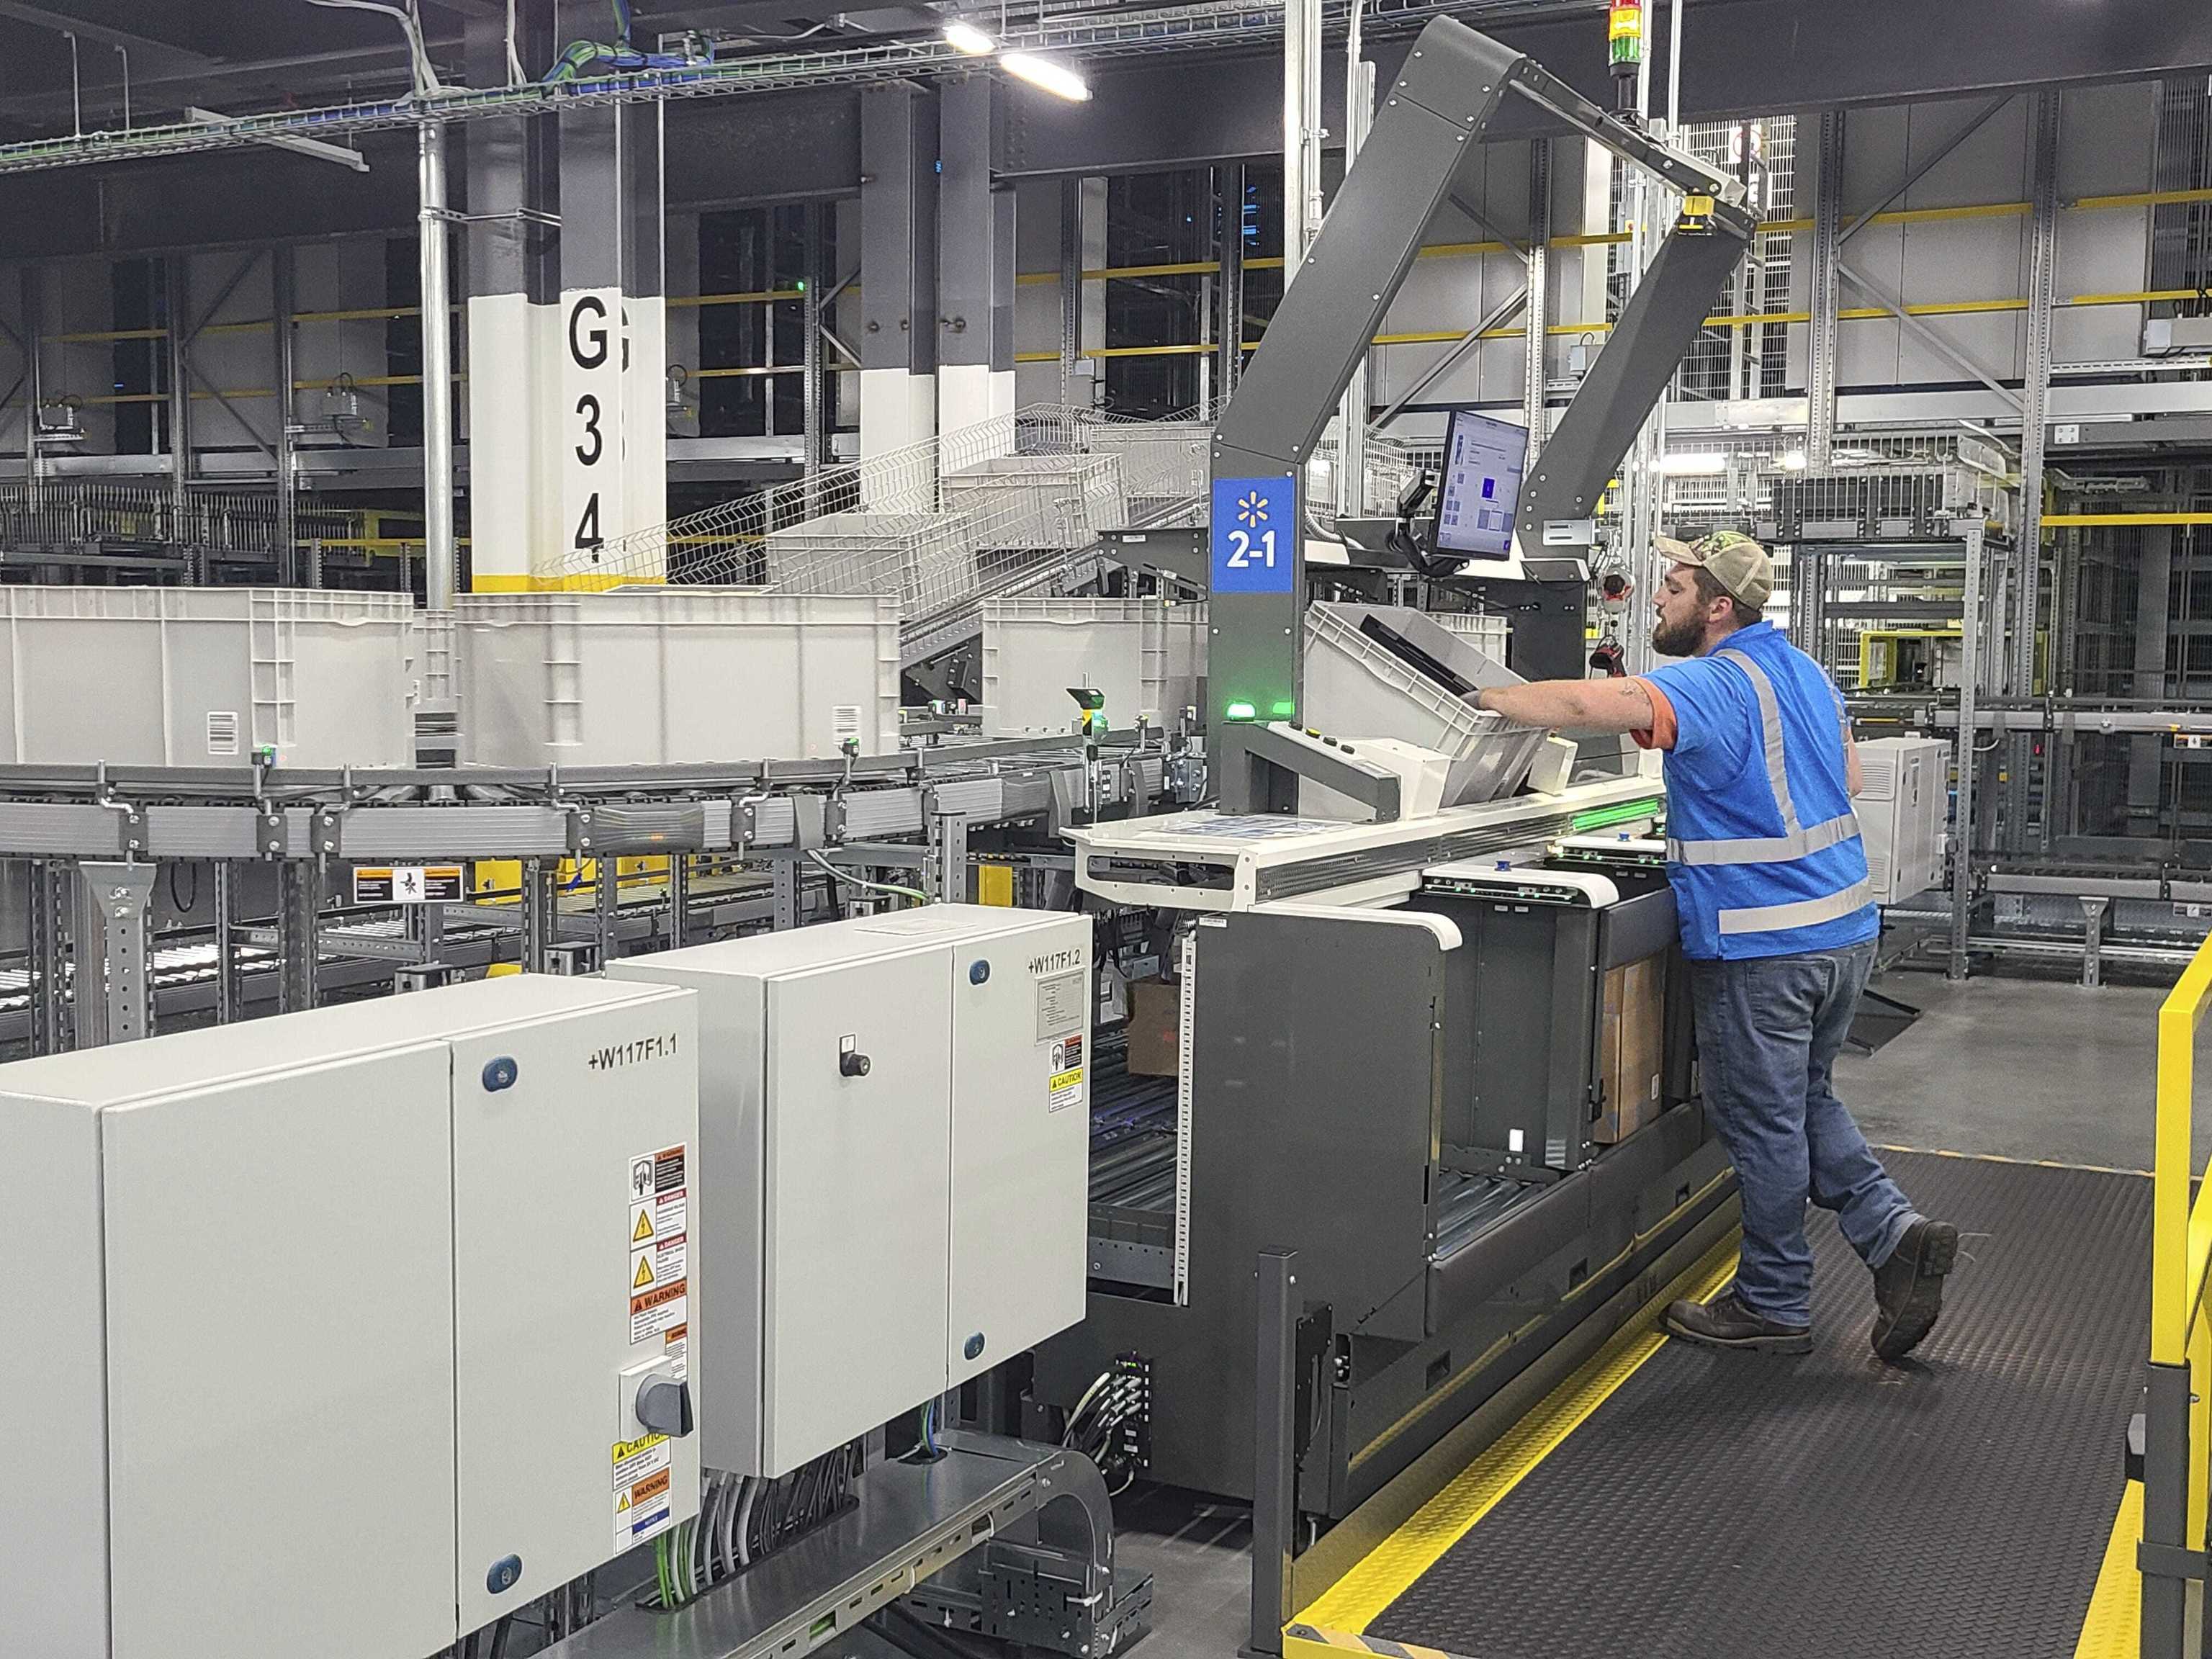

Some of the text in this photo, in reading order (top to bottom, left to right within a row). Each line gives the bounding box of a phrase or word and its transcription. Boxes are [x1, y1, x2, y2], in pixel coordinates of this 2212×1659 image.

[1227, 529, 1276, 568] 2-1
[1028, 948, 1081, 974] +W117F1.2
[588, 1033, 676, 1071] +W117F1.1
[645, 1283, 685, 1308] WARNING
[626, 1431, 663, 1453] CAUTIO
